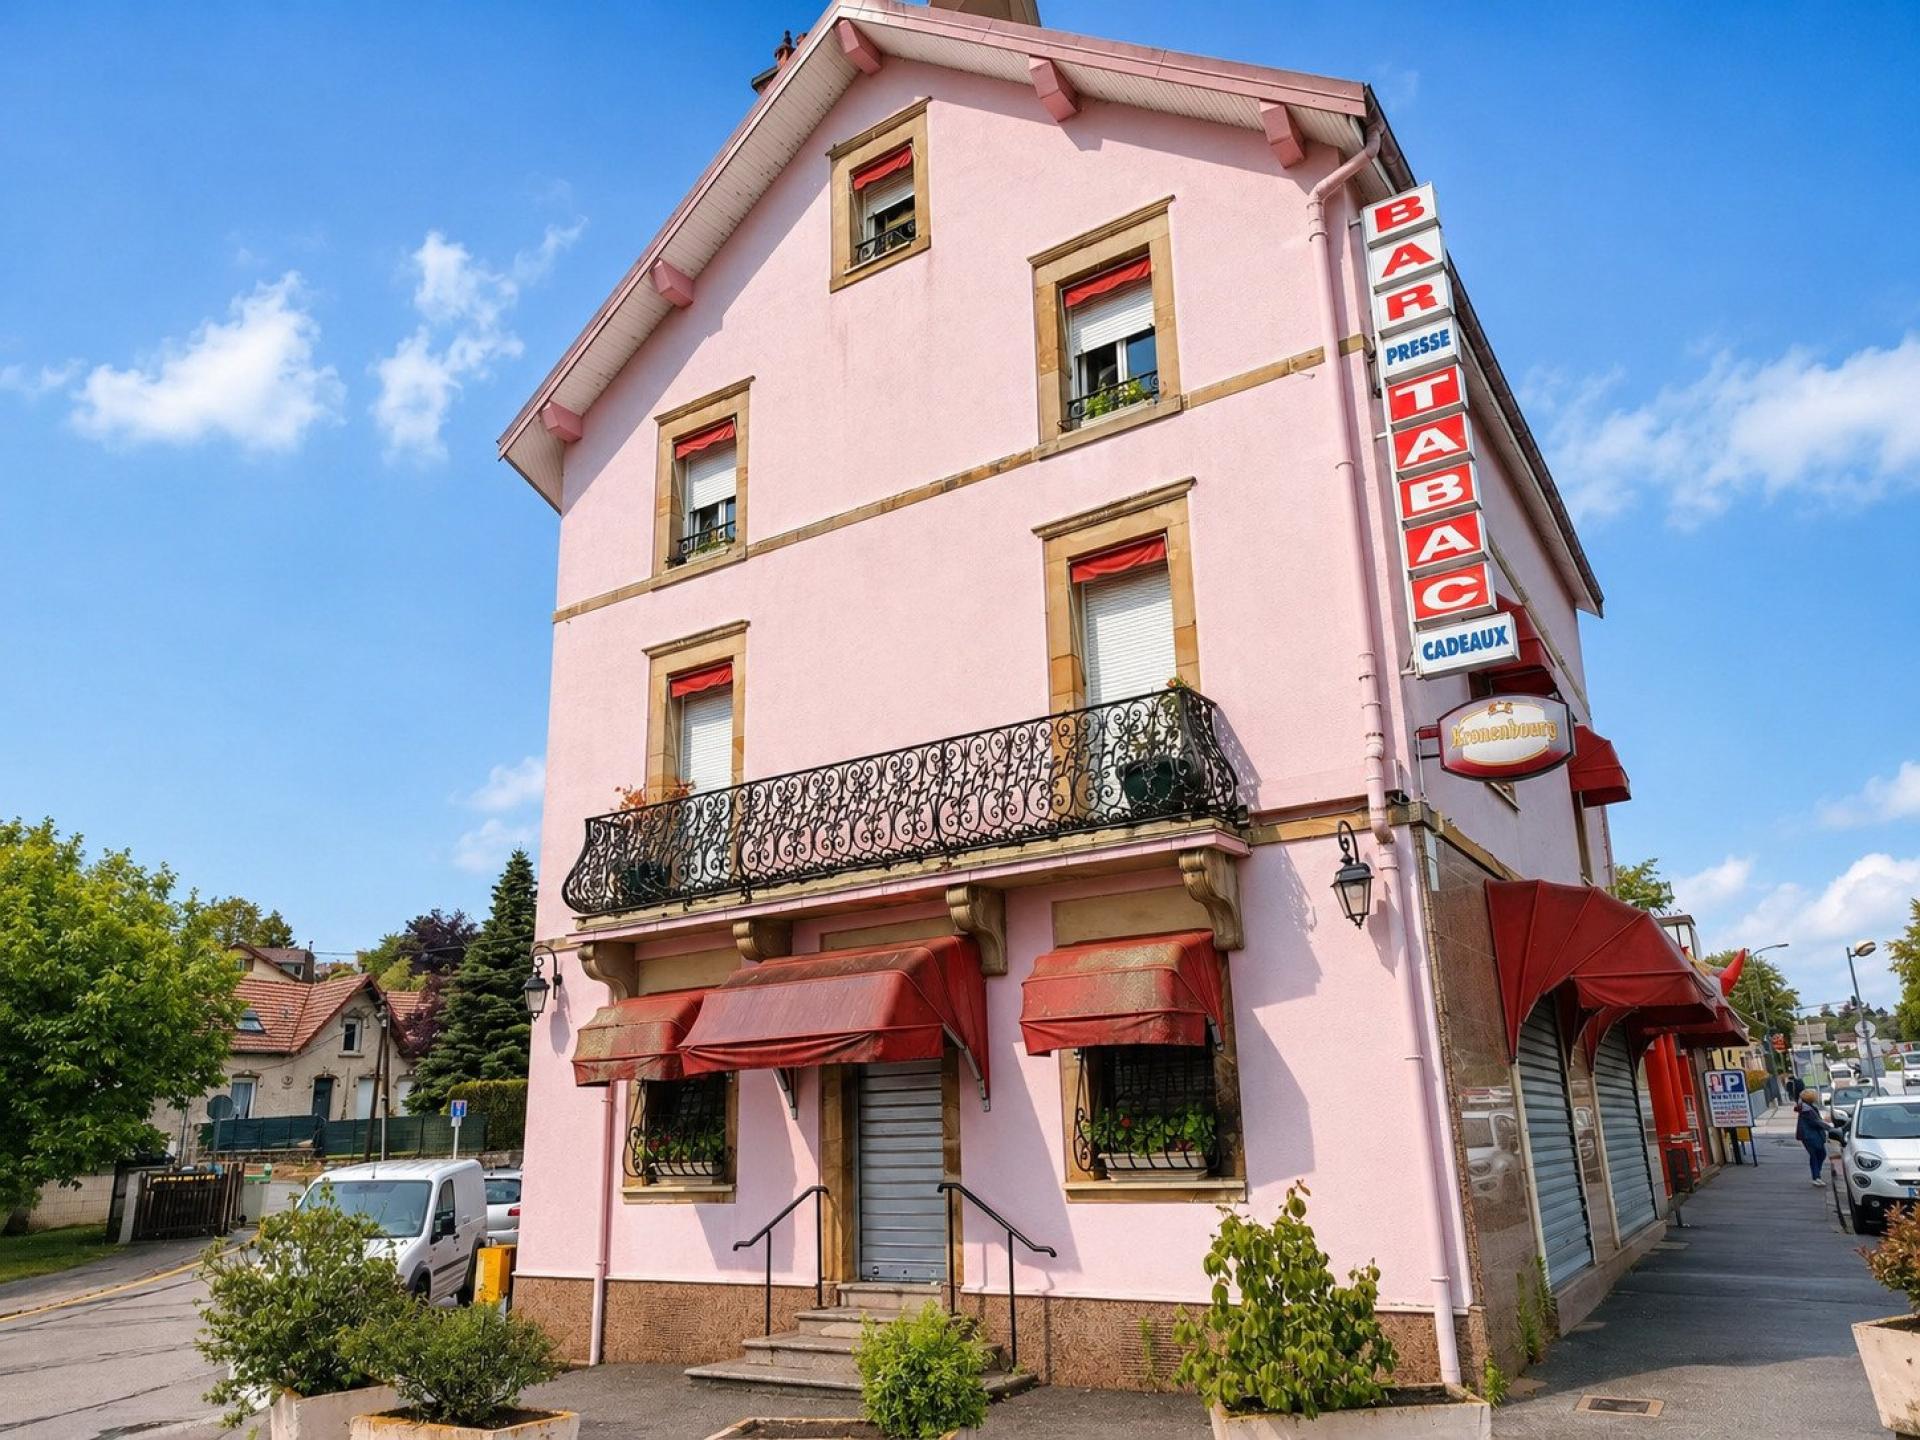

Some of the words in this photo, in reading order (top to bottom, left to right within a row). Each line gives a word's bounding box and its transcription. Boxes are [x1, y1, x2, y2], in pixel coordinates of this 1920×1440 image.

[1374, 195, 1438, 322] BAR
[1386, 328, 1451, 366] PRESSE
[1395, 374, 1479, 610] TABAC
[1422, 625, 1509, 661] CADEAUX
[1451, 718, 1559, 749] Kronenbourg
